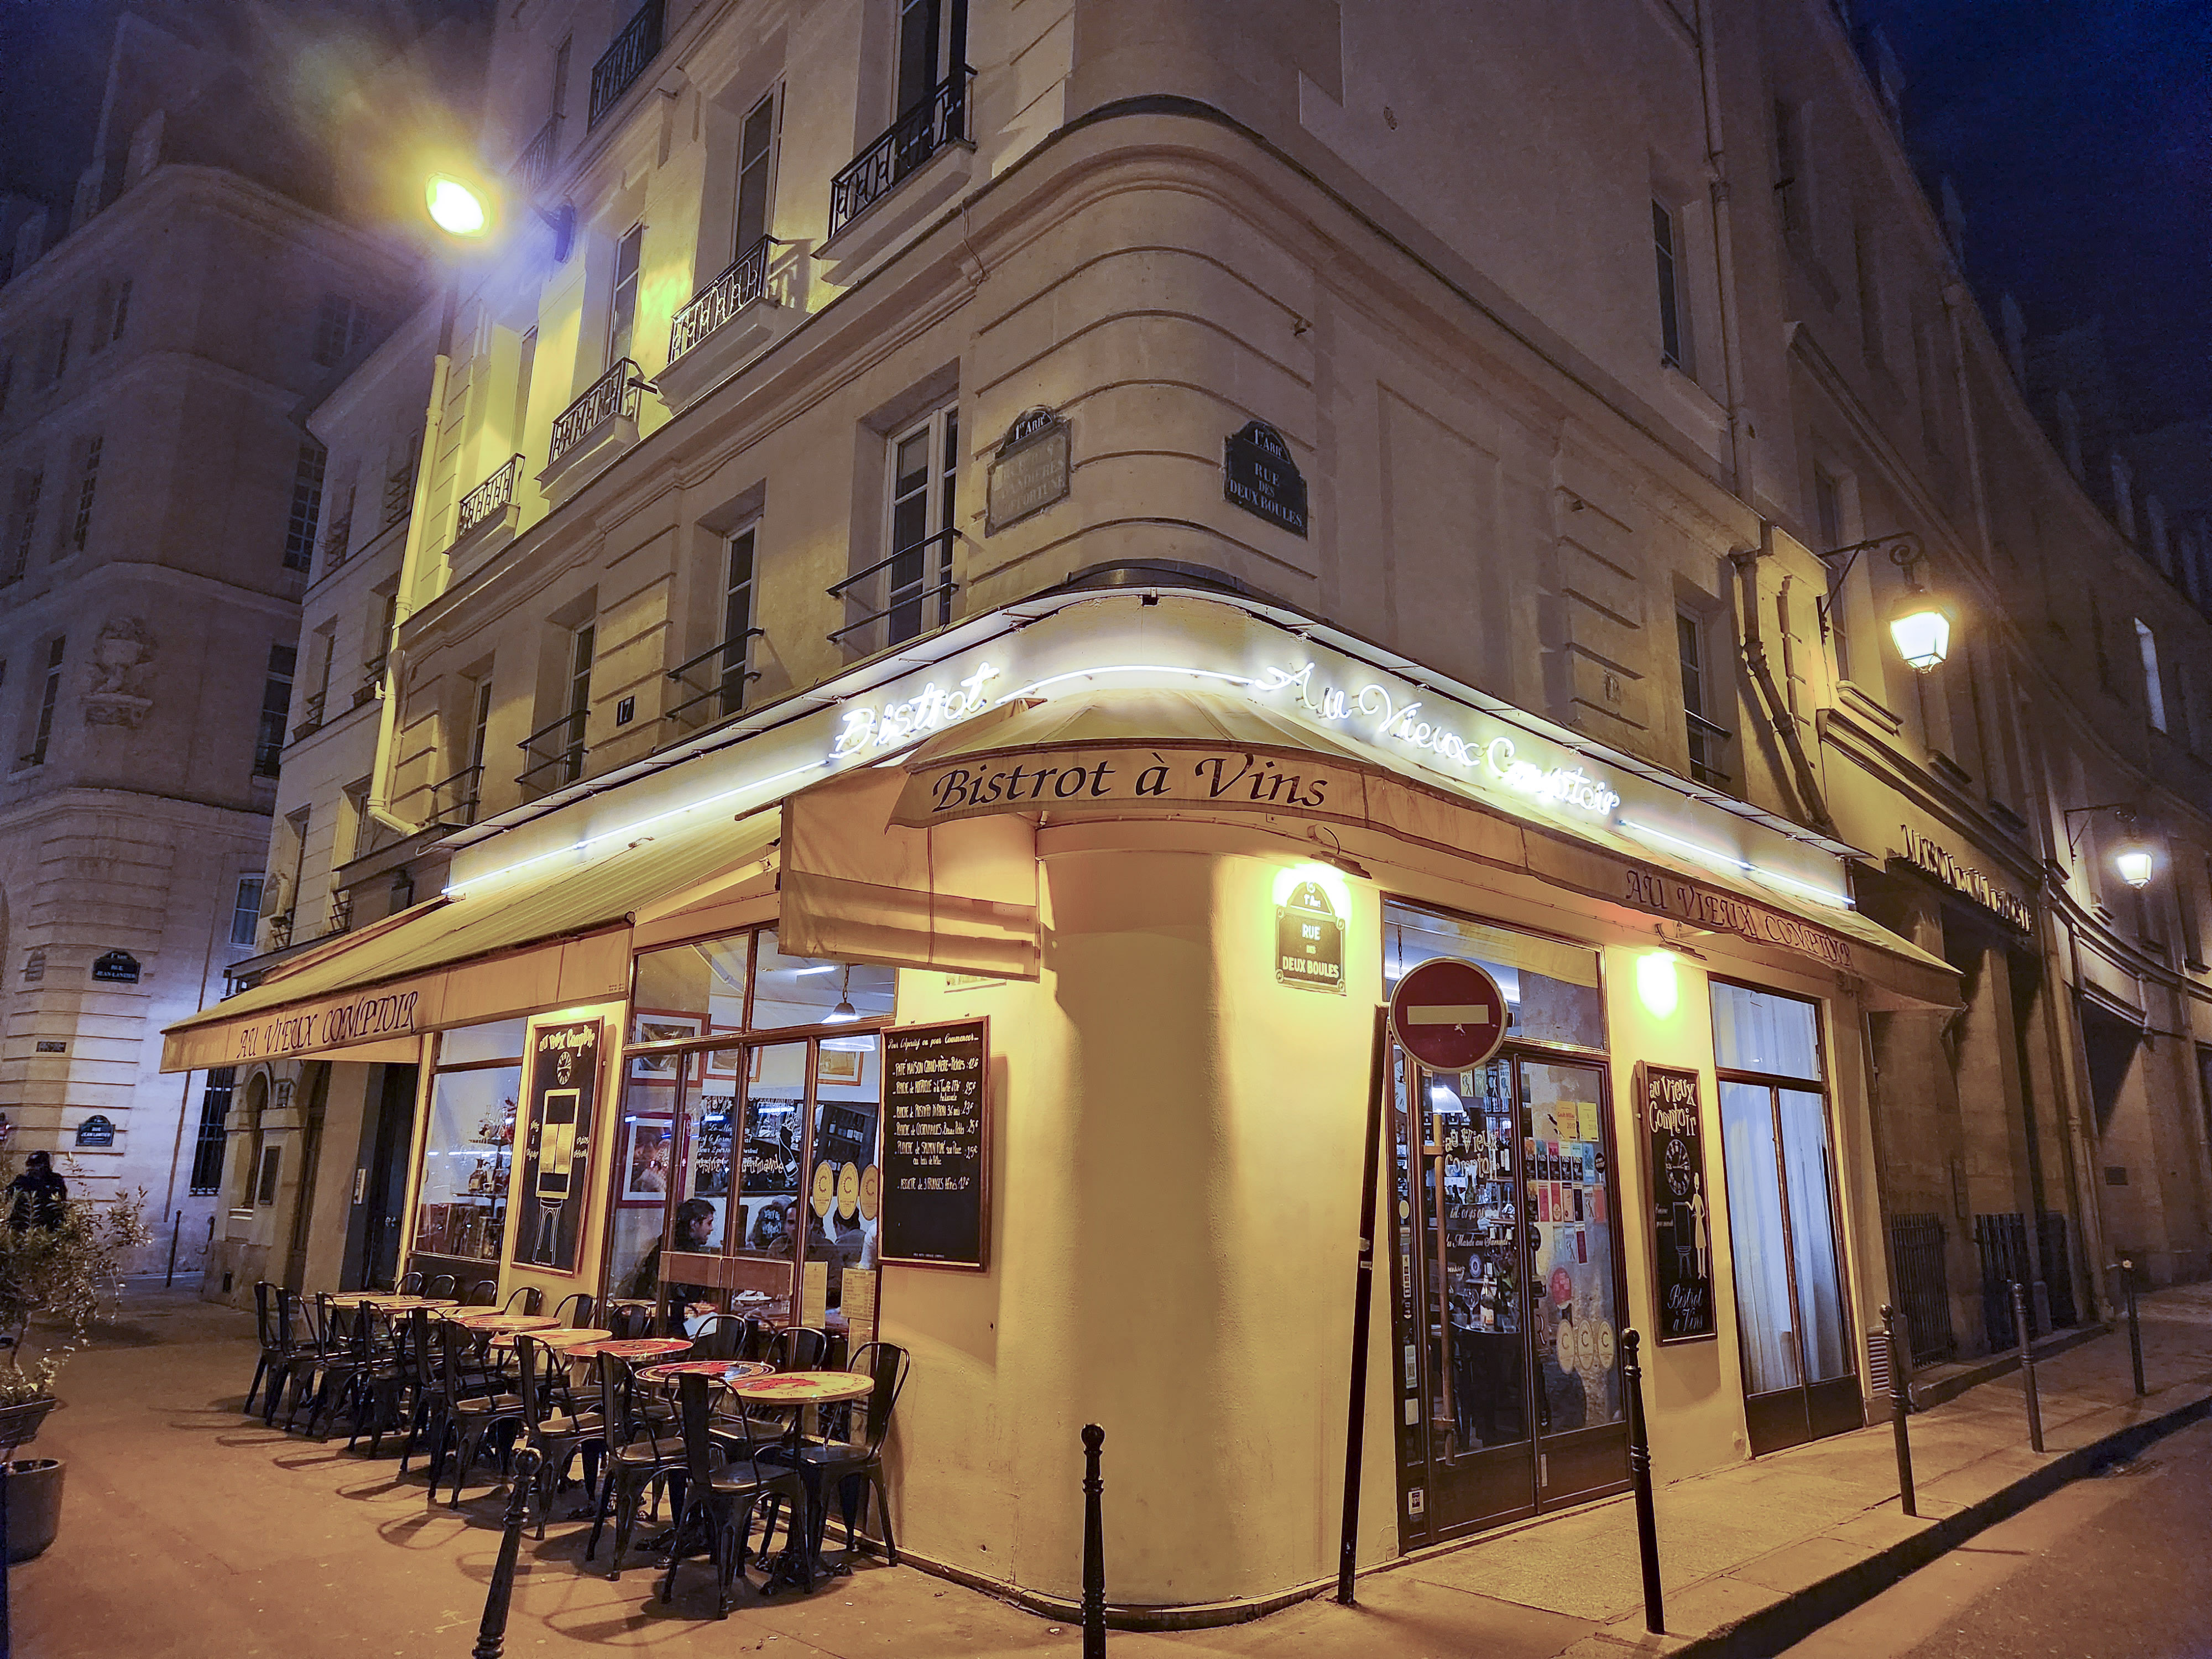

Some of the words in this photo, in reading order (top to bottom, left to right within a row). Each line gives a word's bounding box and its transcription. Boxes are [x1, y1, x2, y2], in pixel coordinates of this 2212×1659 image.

[1255, 462, 1280, 487] RUE
[1259, 480, 1275, 498] DES
[1230, 479, 1259, 506] DEUX
[1261, 495, 1303, 528] BOULES
[619, 698, 632, 723] 17
[828, 661, 1000, 759] Bistrot
[1254, 662, 1352, 720] Au
[1358, 684, 1481, 767] Vieux
[1488, 737, 1621, 816] Comptoir
[932, 760, 1117, 813] Bistrot
[1135, 752, 1172, 797] à
[1194, 753, 1329, 807] Vins
[1626, 869, 1668, 910] AU
[1677, 885, 1759, 940] VIEUX
[1765, 915, 1853, 966] COMPTOIR
[1302, 924, 1321, 941] RUE
[1306, 944, 1316, 954] DES
[1282, 955, 1306, 973] DEUX
[1307, 959, 1340, 979] BOULES
[236, 1026, 259, 1058] AU
[264, 1013, 318, 1055] VIEUX
[321, 990, 419, 1045] COMPTOIR
[930, 1037, 942, 1048] pour
[1667, 1284, 1703, 1309] Bistrot
